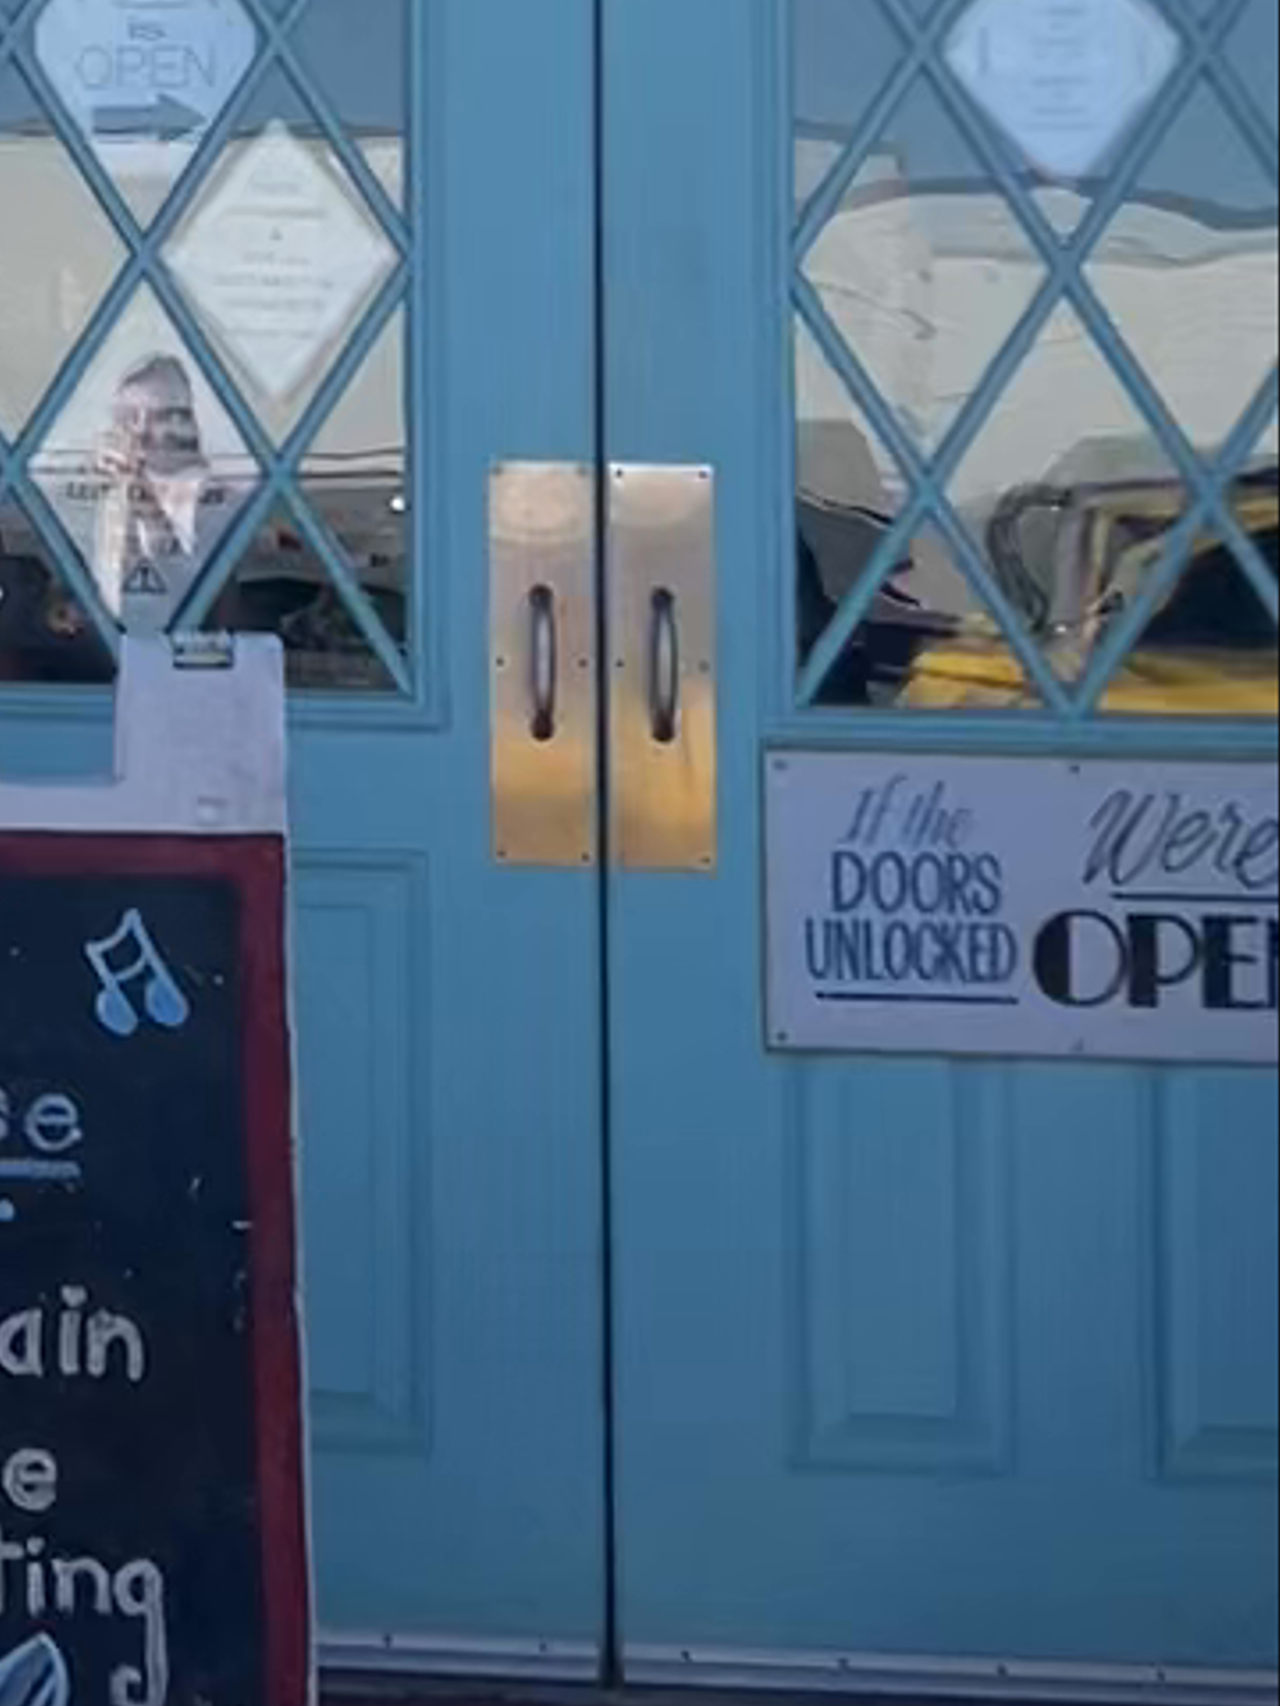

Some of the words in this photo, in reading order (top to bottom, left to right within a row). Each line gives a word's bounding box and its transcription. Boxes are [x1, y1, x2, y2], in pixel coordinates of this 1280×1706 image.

[74, 45, 217, 90] OPEN
[903, 780, 975, 849] the
[831, 850, 1003, 916] DOORS
[805, 917, 1020, 984] UNLOCKED
[1031, 909, 1278, 1010] OPE
